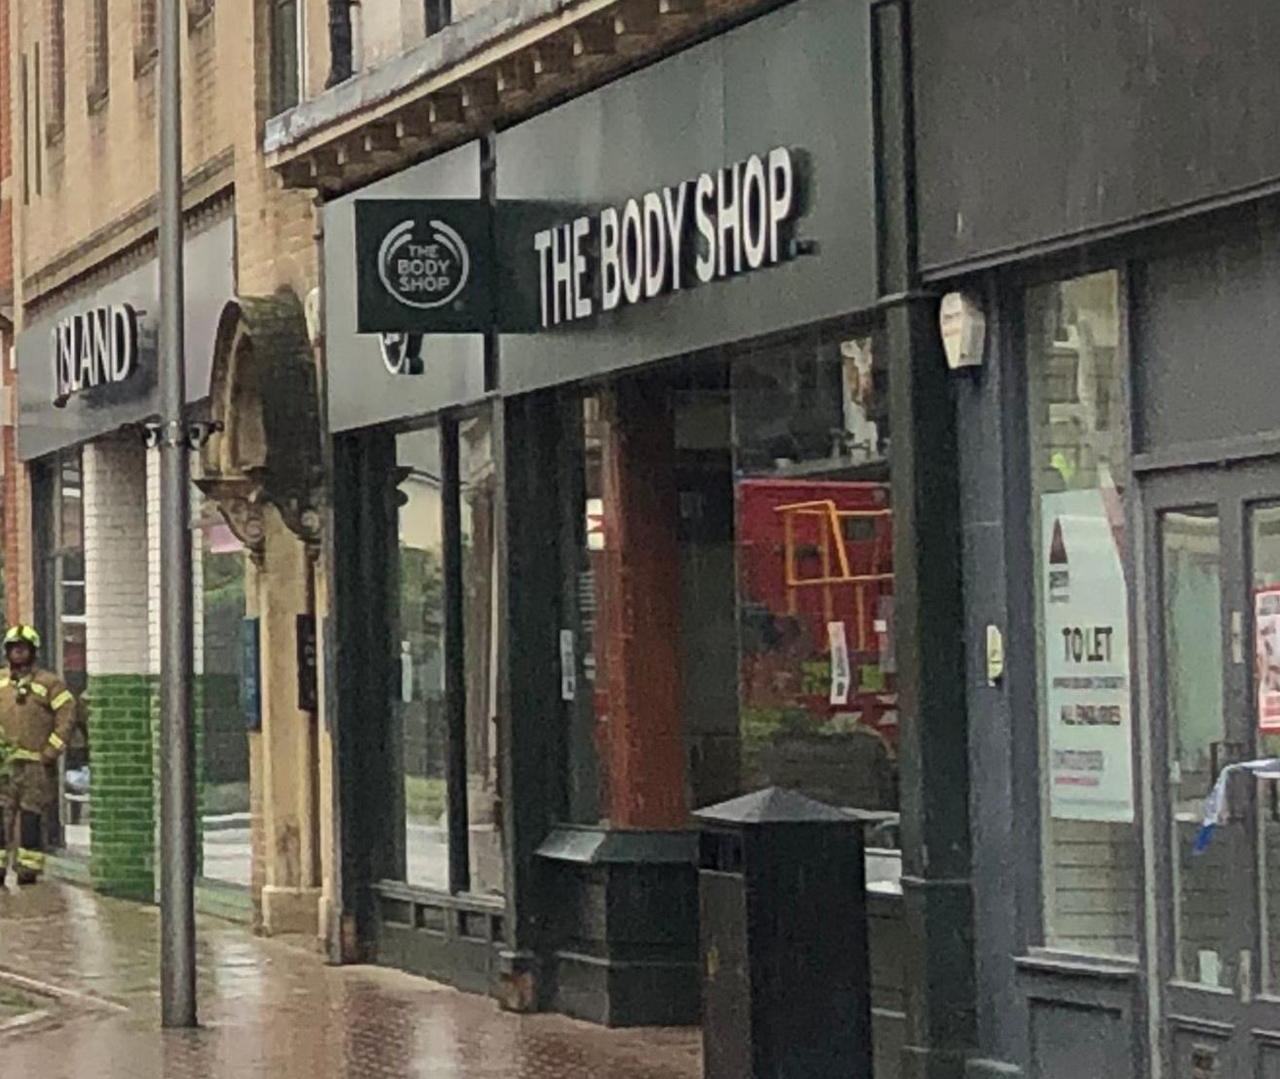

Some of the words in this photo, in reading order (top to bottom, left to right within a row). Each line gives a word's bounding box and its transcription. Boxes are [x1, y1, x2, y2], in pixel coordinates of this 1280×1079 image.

[535, 216, 591, 328] THE
[600, 184, 689, 312] BODY
[695, 146, 793, 283] SHOP
[408, 245, 439, 258] THE
[397, 259, 451, 275] BODY
[399, 276, 451, 292] SHOP
[51, 304, 131, 396] ISLAND
[1062, 626, 1084, 663] TO
[1086, 626, 1113, 663] LET
